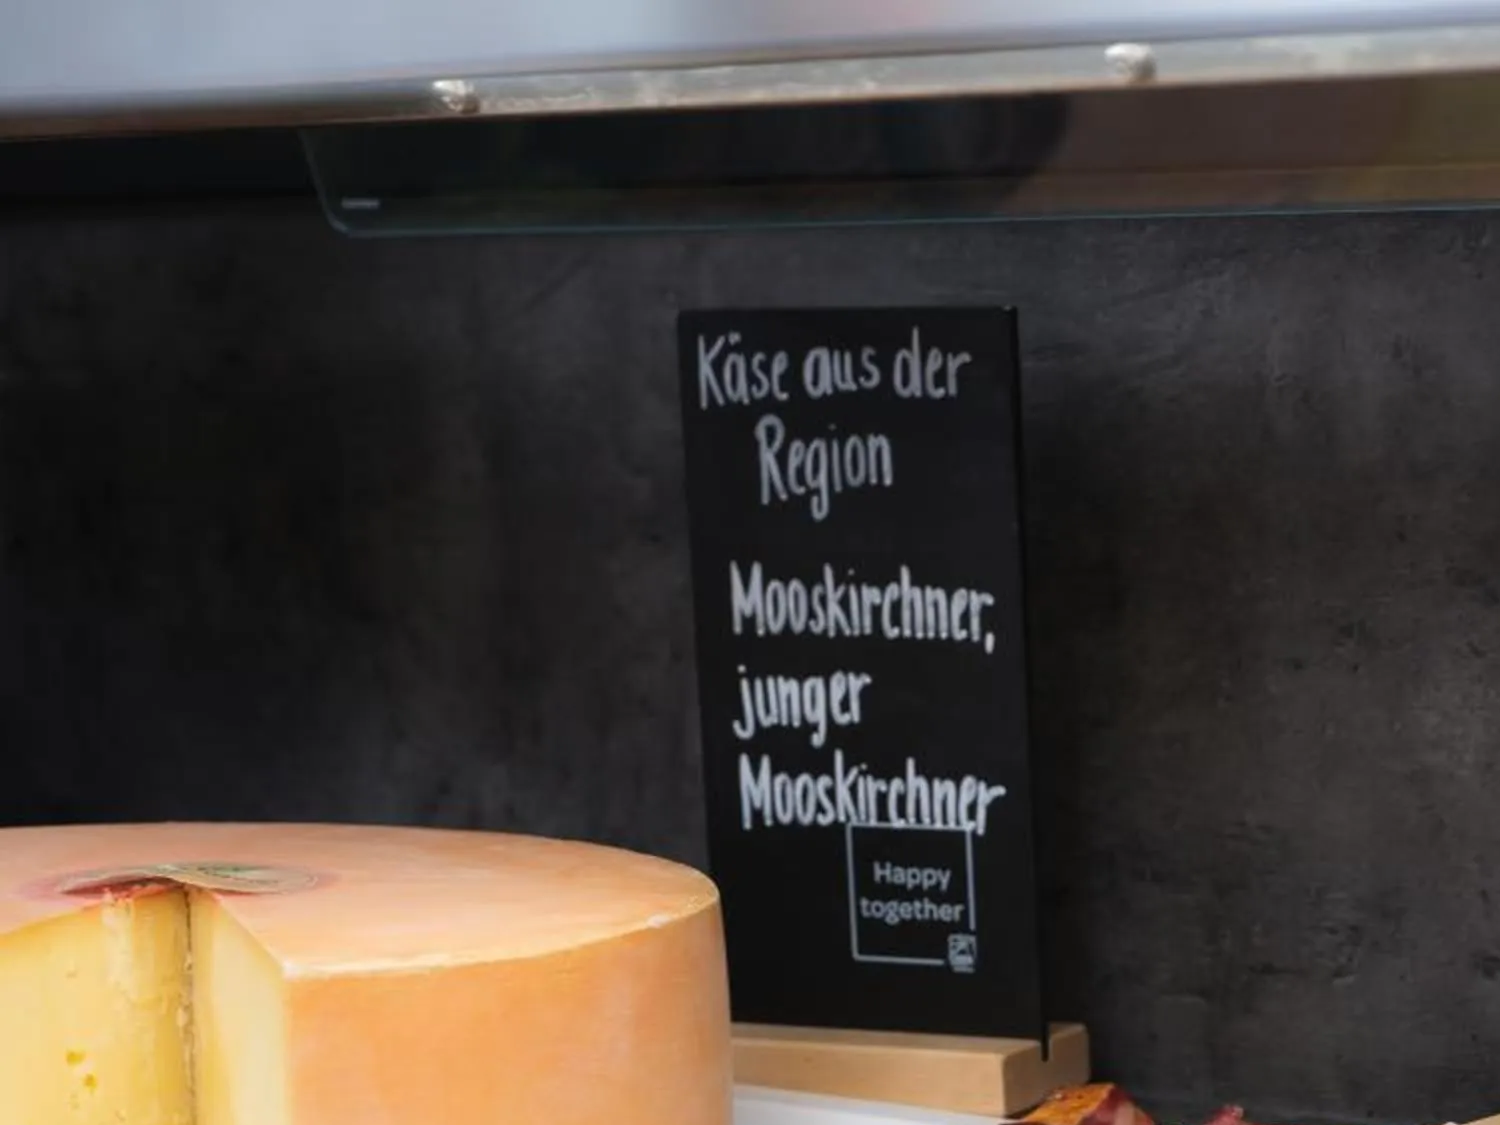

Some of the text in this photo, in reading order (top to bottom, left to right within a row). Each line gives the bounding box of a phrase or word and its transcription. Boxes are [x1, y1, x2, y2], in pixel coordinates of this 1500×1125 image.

[698, 326, 972, 410] Käse aus der
[755, 414, 893, 521] Region
[730, 560, 995, 654] Mooskirchner,
[733, 665, 872, 748] junger
[739, 749, 1006, 835] Mooskirchner
[860, 897, 965, 925] together
[873, 861, 952, 890] Happy
